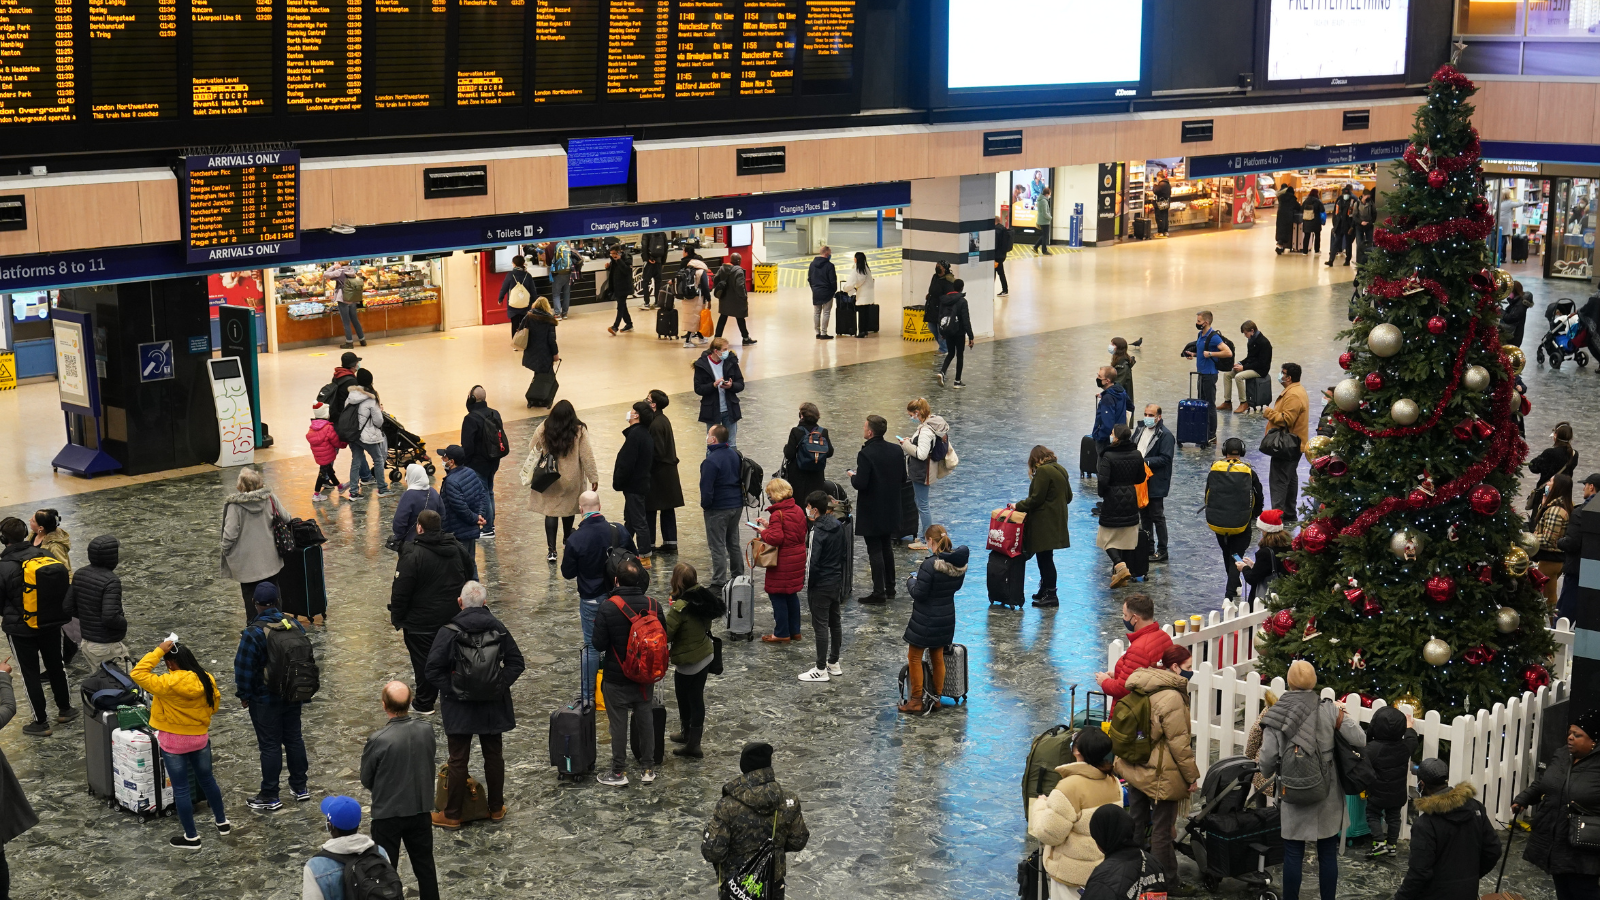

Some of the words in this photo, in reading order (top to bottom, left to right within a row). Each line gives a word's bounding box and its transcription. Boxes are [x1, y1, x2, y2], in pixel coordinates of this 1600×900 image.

[19, 106, 69, 114] Overground
[208, 155, 253, 167] ARRIVALS
[256, 154, 280, 164] ONLY
[1243, 157, 1267, 167] Platforms
[1268, 156, 1272, 164] 4
[779, 204, 804, 213] Changing
[703, 211, 724, 220] Toilets
[591, 221, 619, 231] Changing
[620, 220, 639, 229] Places
[260, 233, 294, 241] 10:41:46
[496, 228, 521, 238] Toilets
[209, 246, 253, 259] ARRIVALS
[256, 244, 280, 254] ONLY
[59, 261, 67, 274] 8
[71, 262, 85, 273] to
[89, 258, 105, 272] 11
